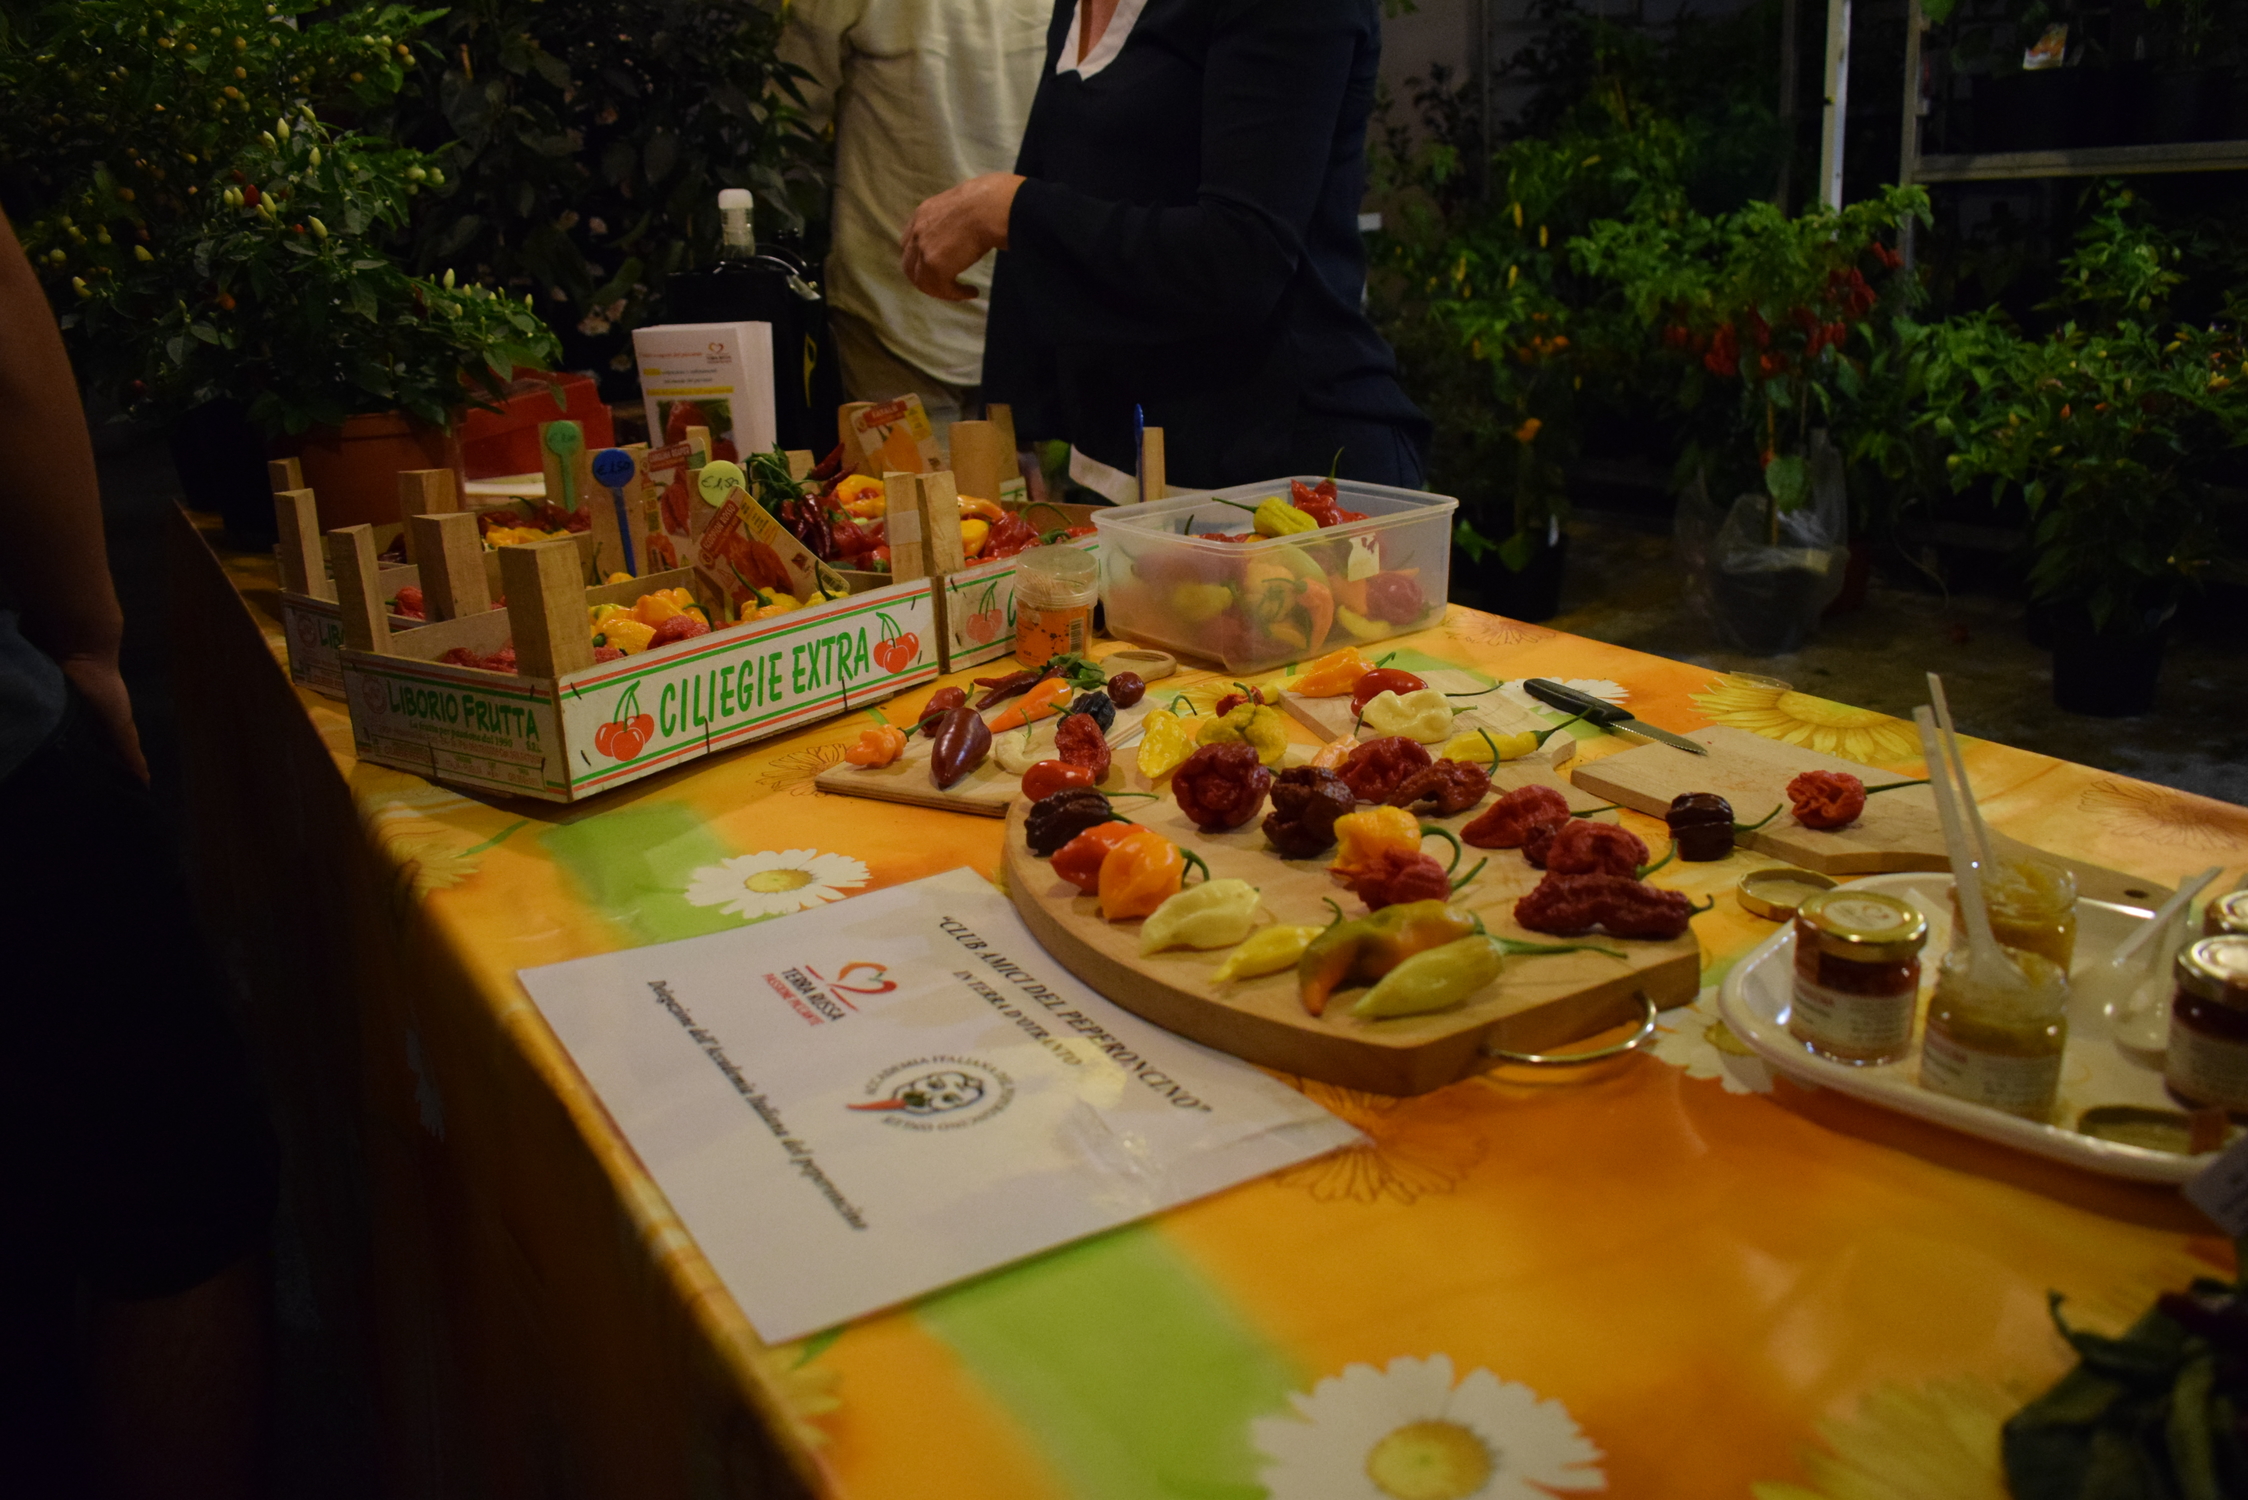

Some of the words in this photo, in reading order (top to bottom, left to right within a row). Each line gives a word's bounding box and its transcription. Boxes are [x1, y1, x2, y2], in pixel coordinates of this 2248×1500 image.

[702, 524, 726, 551] SCORPION
[720, 502, 737, 525] ROSSO
[660, 651, 783, 738] CILIEGIE
[793, 633, 870, 693] EXTRA
[387, 681, 458, 724] LIBORIO
[463, 694, 540, 741] FRUTTA
[648, 980, 696, 1027] Delegazione
[762, 972, 797, 1000] PASSIONE
[782, 966, 816, 994] TERRA
[967, 981, 1012, 1010] TERRA
[975, 952, 1036, 983] AMICI
[1021, 984, 1066, 1010] DEL
[746, 1094, 789, 1136] Italiana
[782, 1138, 814, 1156] del
[790, 1157, 868, 1230] peperoncino
